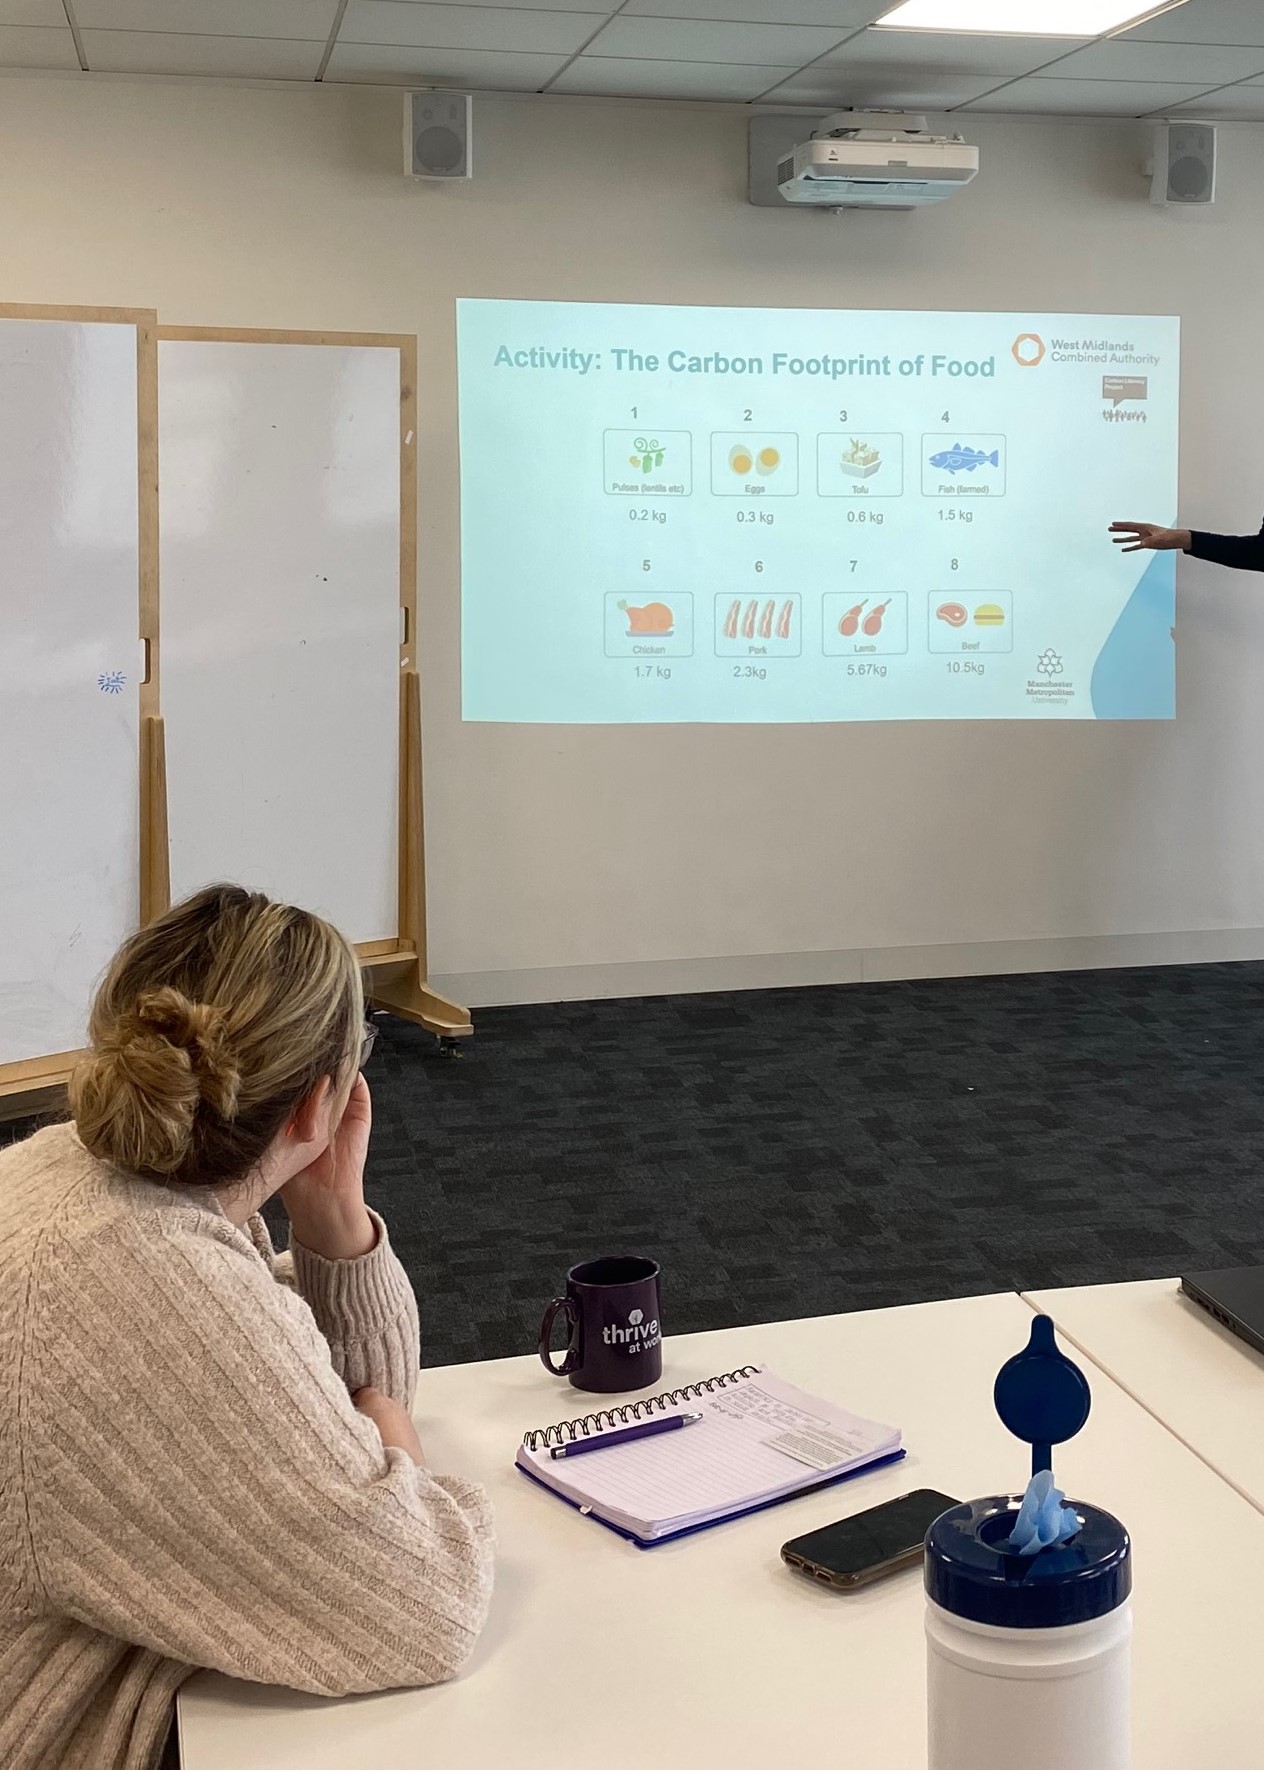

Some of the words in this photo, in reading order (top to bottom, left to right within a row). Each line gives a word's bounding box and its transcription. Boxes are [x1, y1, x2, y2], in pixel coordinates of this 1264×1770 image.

[1051, 339, 1079, 350] West
[1082, 340, 1134, 351] Midlands
[494, 345, 601, 375] Activity:
[611, 349, 659, 371] The
[668, 350, 763, 374] Carbon
[772, 353, 891, 380] Footprint
[899, 355, 924, 376] of
[931, 355, 995, 377] Food
[1051, 351, 1108, 363] Combined
[1110, 352, 1160, 366] Authority
[630, 407, 638, 419] 1
[743, 409, 753, 421] 2
[839, 410, 848, 422] 3
[941, 411, 950, 423] 4
[612, 482, 639, 492] Pulses
[668, 484, 685, 494] etc)
[745, 485, 766, 494] Eggs
[852, 485, 869, 494] Tofu
[938, 484, 955, 494] Fish
[629, 509, 648, 520] 0.2
[652, 509, 667, 524] kg
[736, 511, 756, 522] 0.3
[760, 511, 774, 524] kg
[847, 511, 866, 522] 0.6
[870, 511, 884, 524] kg
[938, 509, 956, 520] 1.5
[959, 509, 973, 523] kg
[642, 560, 651, 571] 5
[755, 561, 764, 572] 6
[850, 560, 858, 572] 7
[950, 558, 959, 570] 8
[632, 645, 666, 654] Chicken
[749, 645, 768, 655] Pork
[854, 644, 877, 653] Lamb
[961, 641, 980, 650] Beef
[634, 665, 653, 677] 1.7
[657, 665, 671, 679] kg
[733, 665, 767, 680] 2.3kg
[847, 664, 887, 677] 5.67kg
[946, 662, 985, 675] 10.5kg
[602, 1320, 658, 1345] thrive
[629, 1341, 640, 1354] at
[643, 1331, 662, 1350] wor
